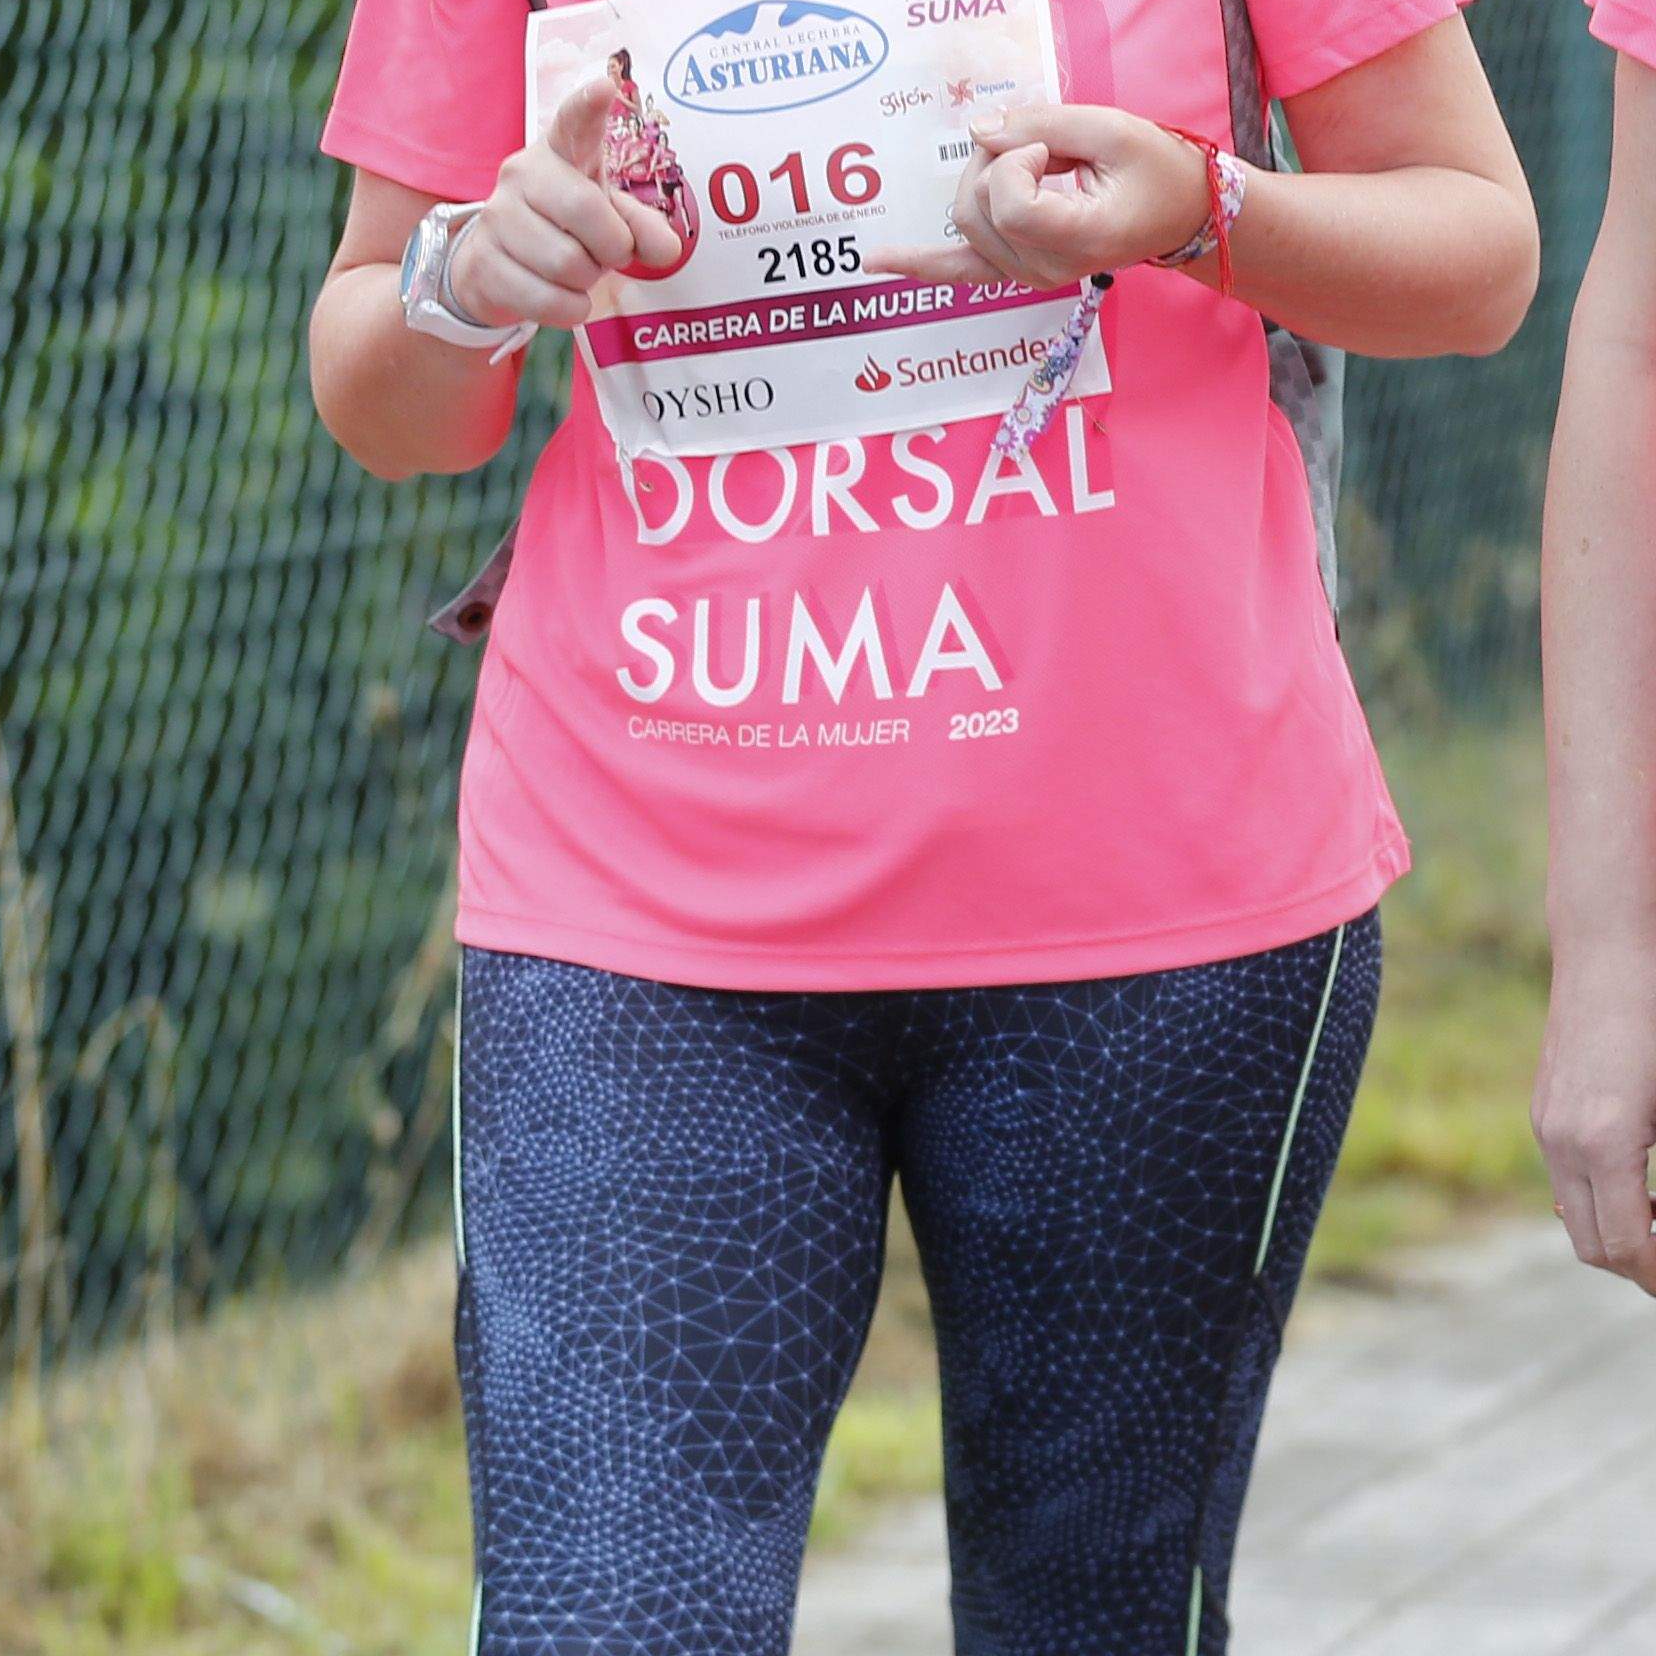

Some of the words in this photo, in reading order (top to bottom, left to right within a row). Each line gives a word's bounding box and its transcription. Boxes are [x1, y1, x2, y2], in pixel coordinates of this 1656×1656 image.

[681, 40, 874, 97] ASTURIANA
[709, 38, 781, 59] CENTRAL
[788, 24, 861, 46] LECHERA
[708, 141, 882, 225] 016
[773, 216, 825, 232] VIOLENCIA
[827, 213, 841, 223] DE
[758, 235, 861, 284] 2185
[634, 315, 761, 350] CARRERA
[769, 307, 805, 332] DE
[813, 301, 846, 328] LA
[853, 286, 954, 323] MUJER
[897, 336, 1054, 387] Santande
[621, 405, 1116, 546] DORSAL
[615, 582, 1003, 707] SUMA
[628, 716, 731, 746] CARRERA
[738, 724, 770, 748] DE
[777, 724, 810, 748] LA
[817, 719, 910, 747] MUJER
[948, 708, 1020, 741] 2023
